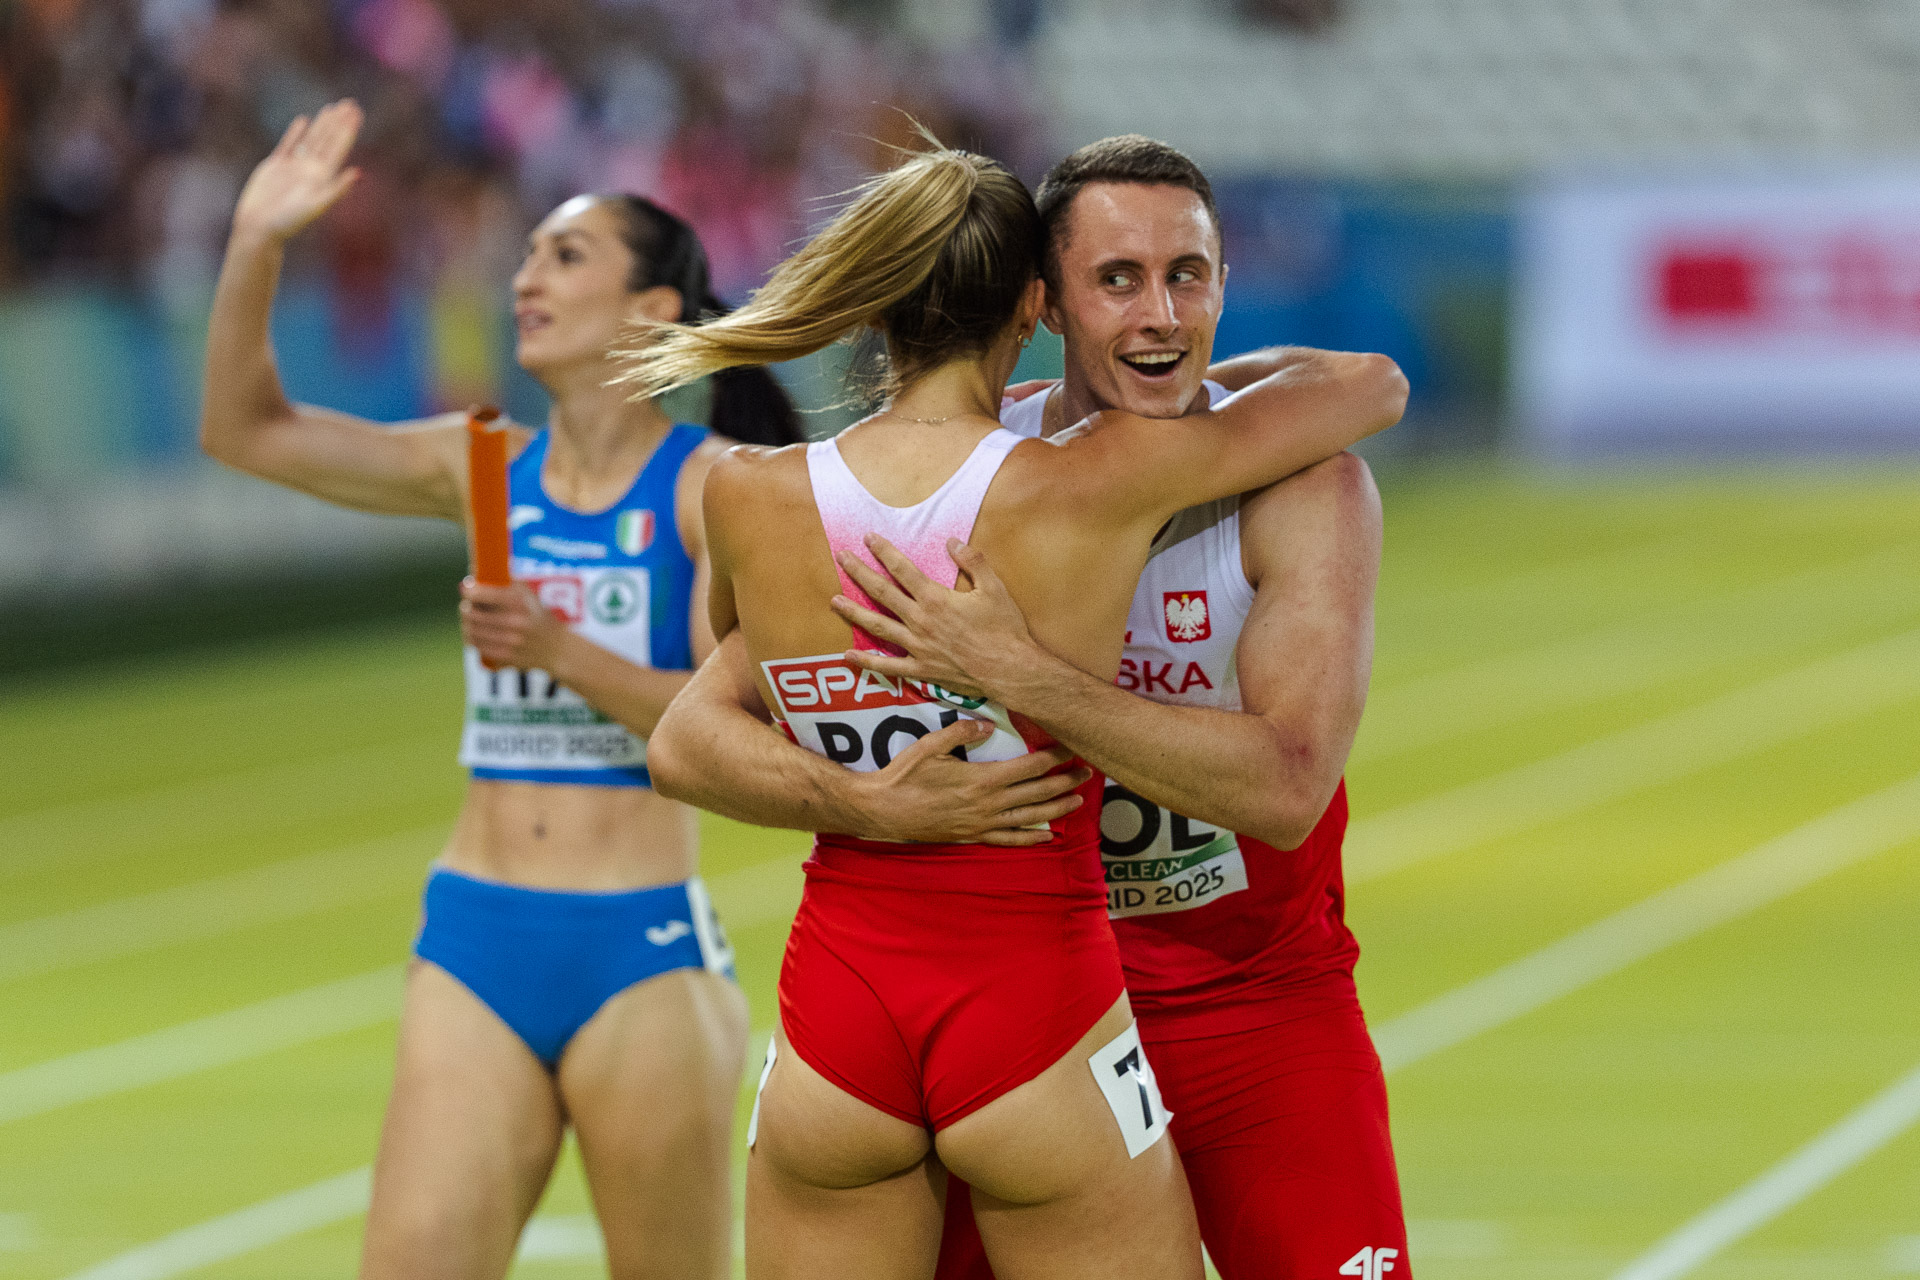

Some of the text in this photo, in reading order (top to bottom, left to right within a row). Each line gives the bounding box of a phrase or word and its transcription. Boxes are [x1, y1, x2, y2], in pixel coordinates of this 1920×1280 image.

[1117, 658, 1214, 694] SKA
[1101, 785, 1216, 857] OL
[1110, 858, 1184, 880] CLEAN
[1154, 864, 1225, 907] 2025
[1338, 1246, 1399, 1280] 4F
